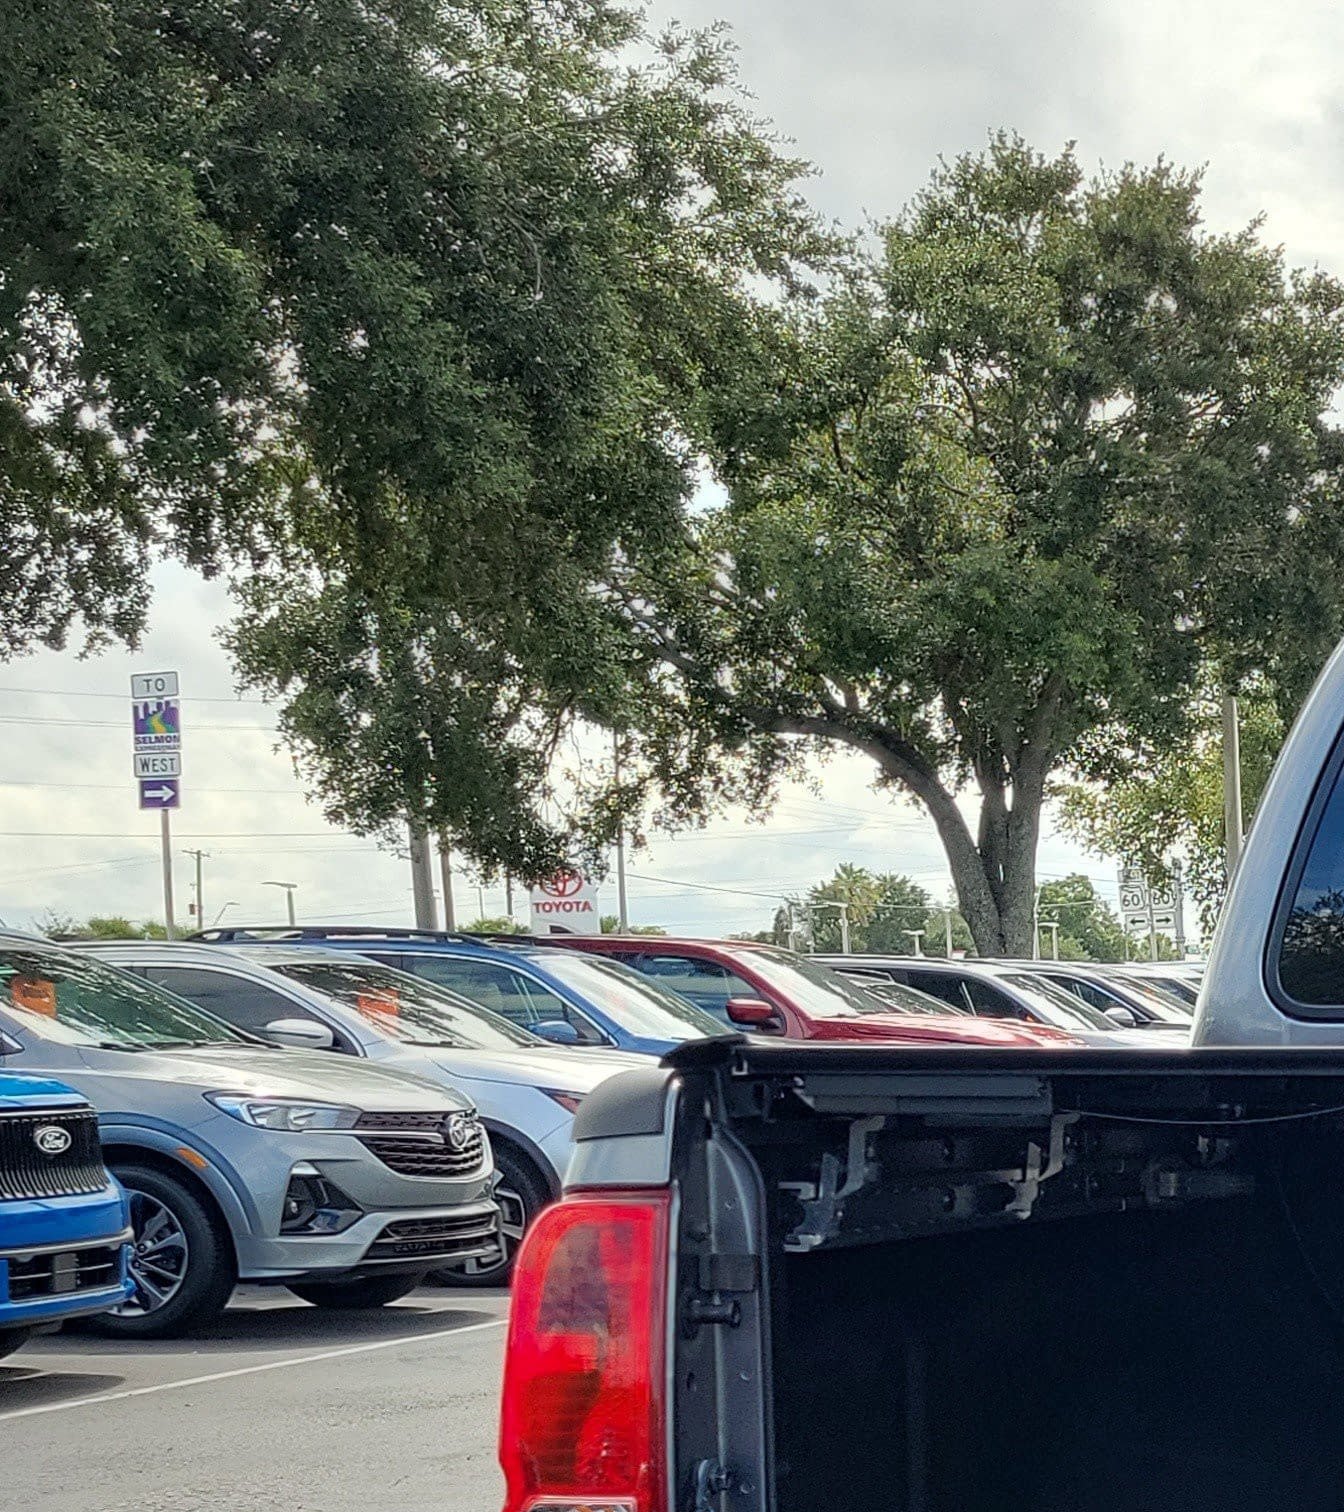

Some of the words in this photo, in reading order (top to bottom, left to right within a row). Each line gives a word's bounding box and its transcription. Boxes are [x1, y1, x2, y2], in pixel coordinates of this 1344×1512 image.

[143, 678, 166, 692] TO
[134, 735, 180, 745] SELMON
[139, 757, 176, 772] WEST
[532, 900, 593, 913] TOYOTA
[1122, 893, 1140, 907] 60
